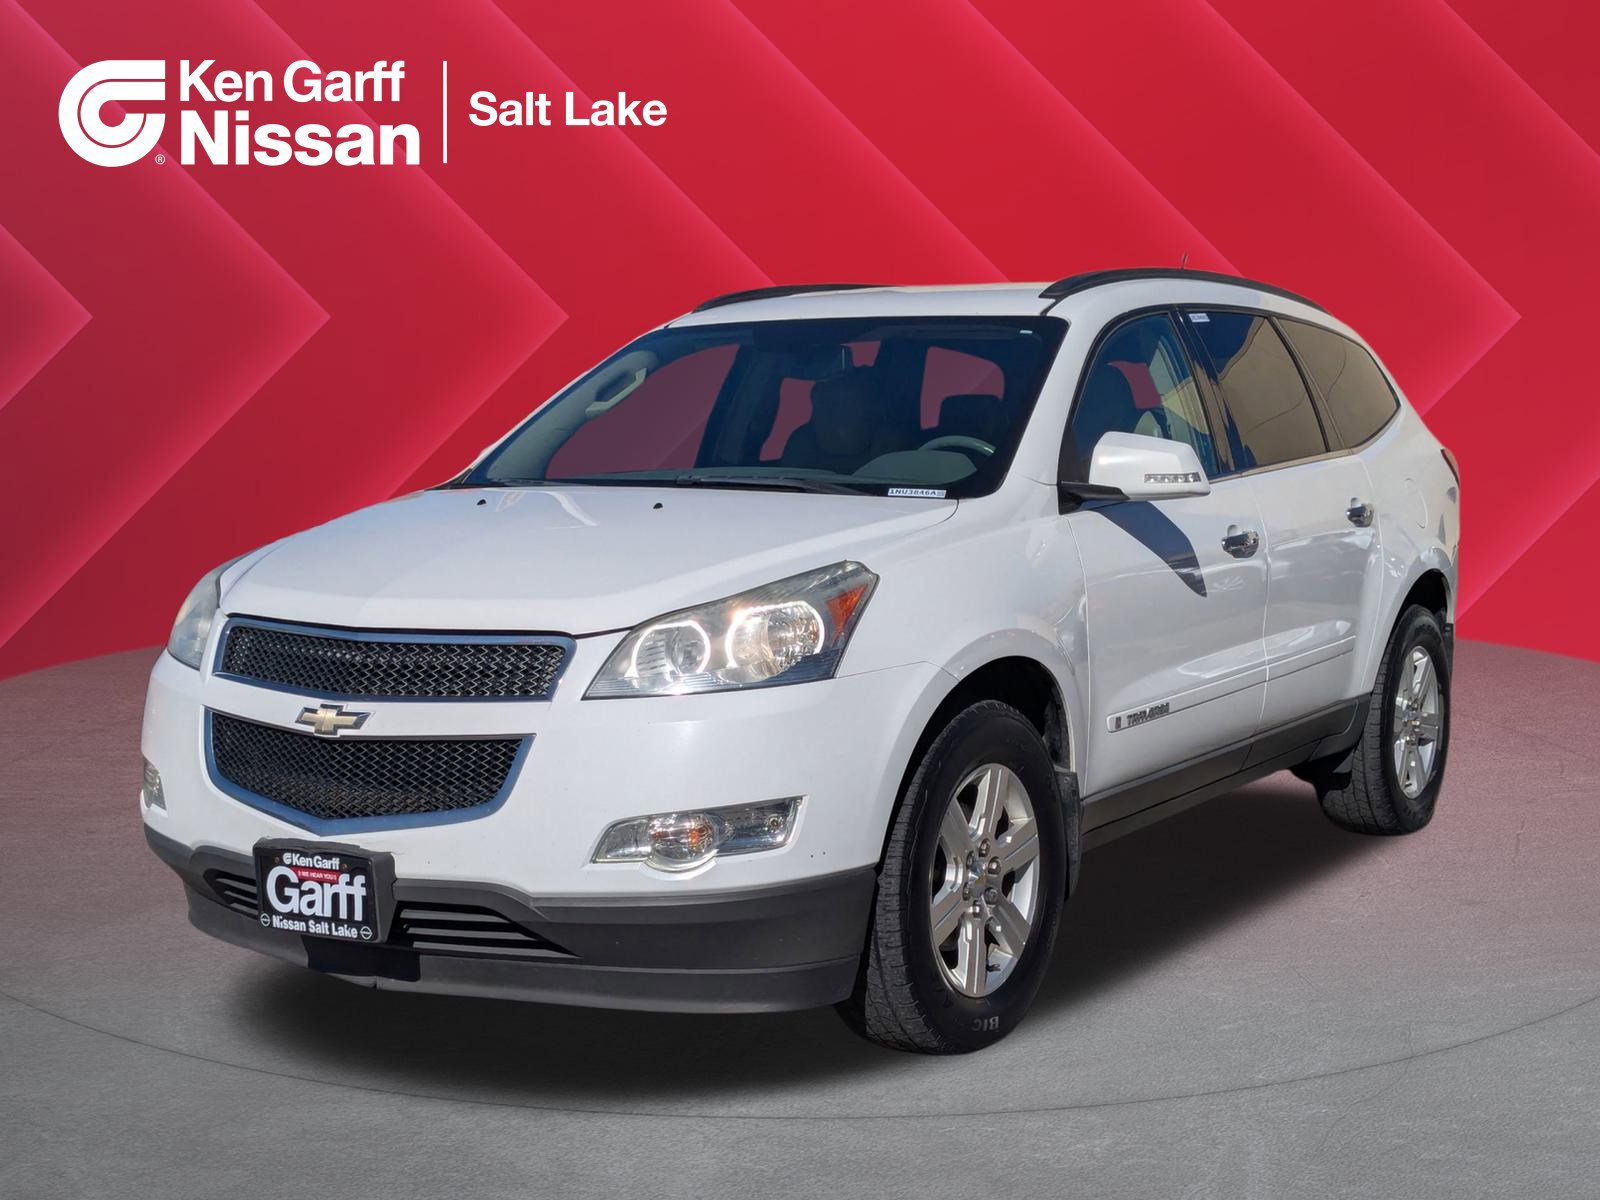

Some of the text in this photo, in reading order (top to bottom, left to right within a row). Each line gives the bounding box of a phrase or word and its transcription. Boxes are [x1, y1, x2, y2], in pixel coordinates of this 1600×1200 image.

[292, 853, 340, 870] Ken Garff
[266, 865, 367, 922] Garff
[272, 915, 358, 938] Nissan Salt Lake
